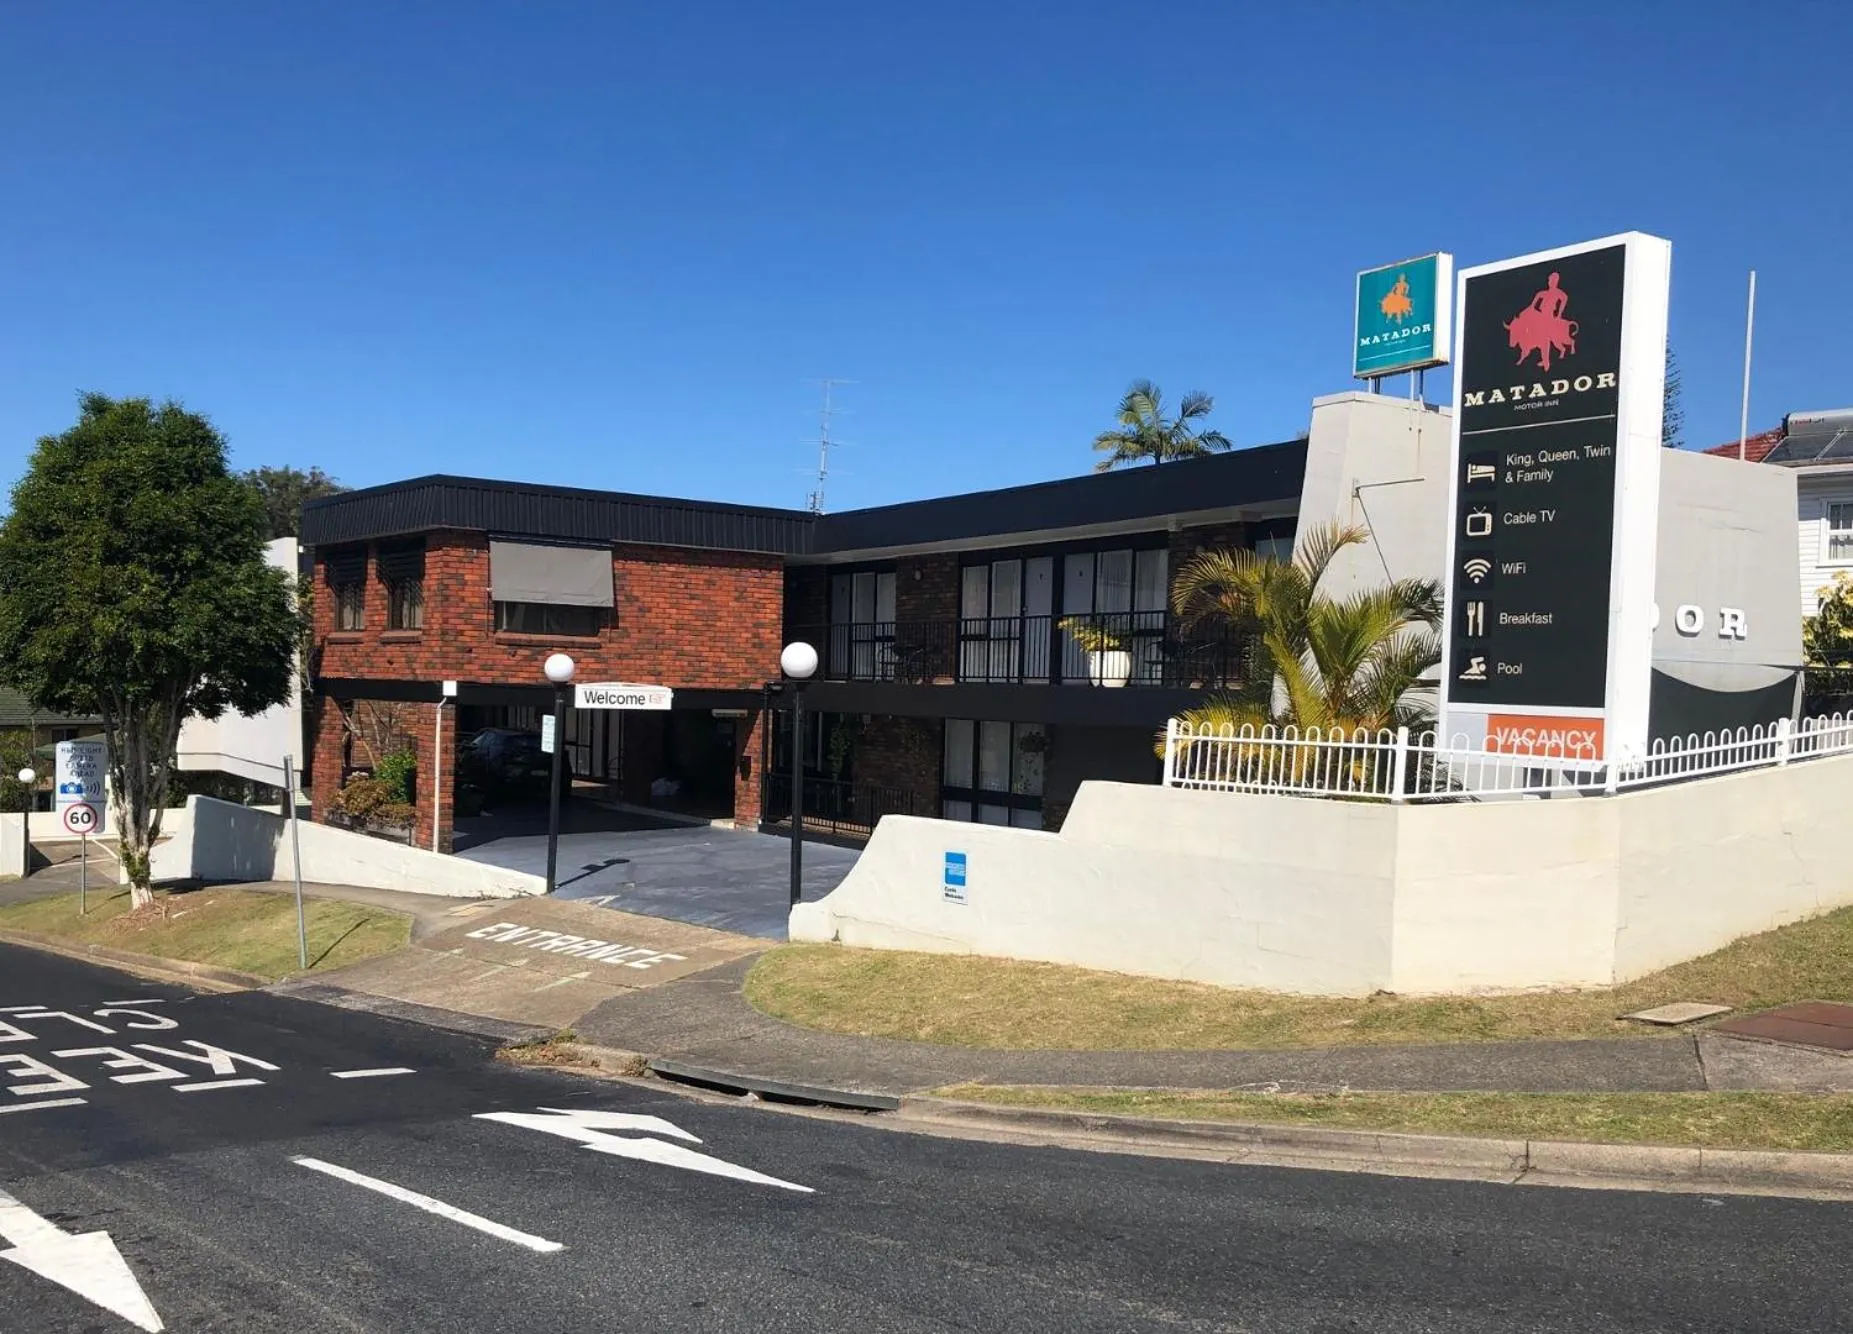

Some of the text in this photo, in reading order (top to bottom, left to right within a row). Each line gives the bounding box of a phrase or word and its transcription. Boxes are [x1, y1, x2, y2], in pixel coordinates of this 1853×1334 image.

[1360, 324, 1431, 346] MATADOR
[1464, 373, 1616, 406] MATADOR
[1514, 398, 1559, 411] MOTOR INN
[1506, 445, 1611, 467] King, Queen, Twin
[1505, 469, 1553, 483] & Family
[1503, 509, 1556, 525] Cable TV
[1502, 562, 1526, 574] WiFi
[1499, 612, 1552, 625] Breakfast
[1652, 602, 1748, 640] OR
[1497, 662, 1523, 674] Pool
[584, 690, 646, 705] Welcome
[1496, 726, 1596, 749] VACANCY
[70, 811, 91, 824] 60
[464, 922, 688, 969] ENTRANCE
